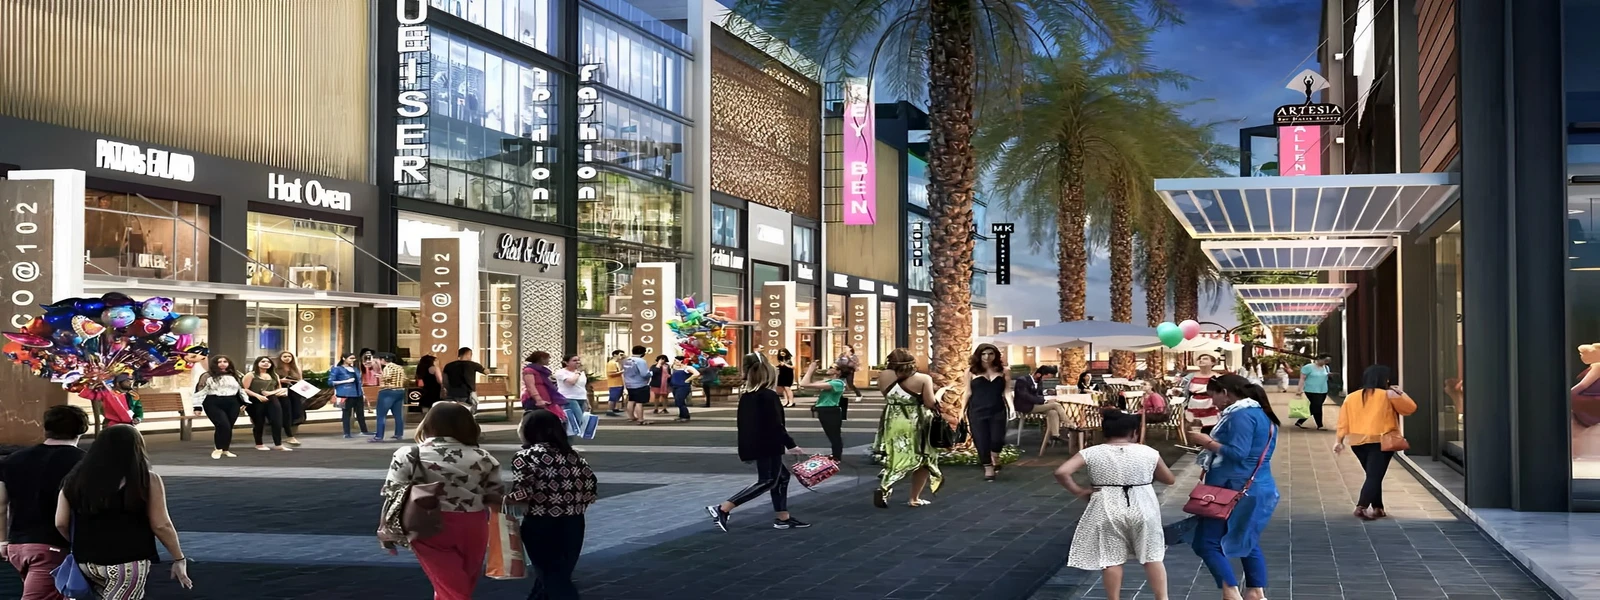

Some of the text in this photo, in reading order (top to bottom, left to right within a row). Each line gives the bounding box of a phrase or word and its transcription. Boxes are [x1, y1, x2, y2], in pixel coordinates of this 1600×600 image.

[577, 64, 599, 199] fashion
[1277, 105, 1341, 116] ARTESIA
[268, 173, 351, 211] Hot Oven
[851, 161, 868, 214] BEN
[431, 253, 451, 353] SCO@102
[768, 294, 782, 356] SCO@102
